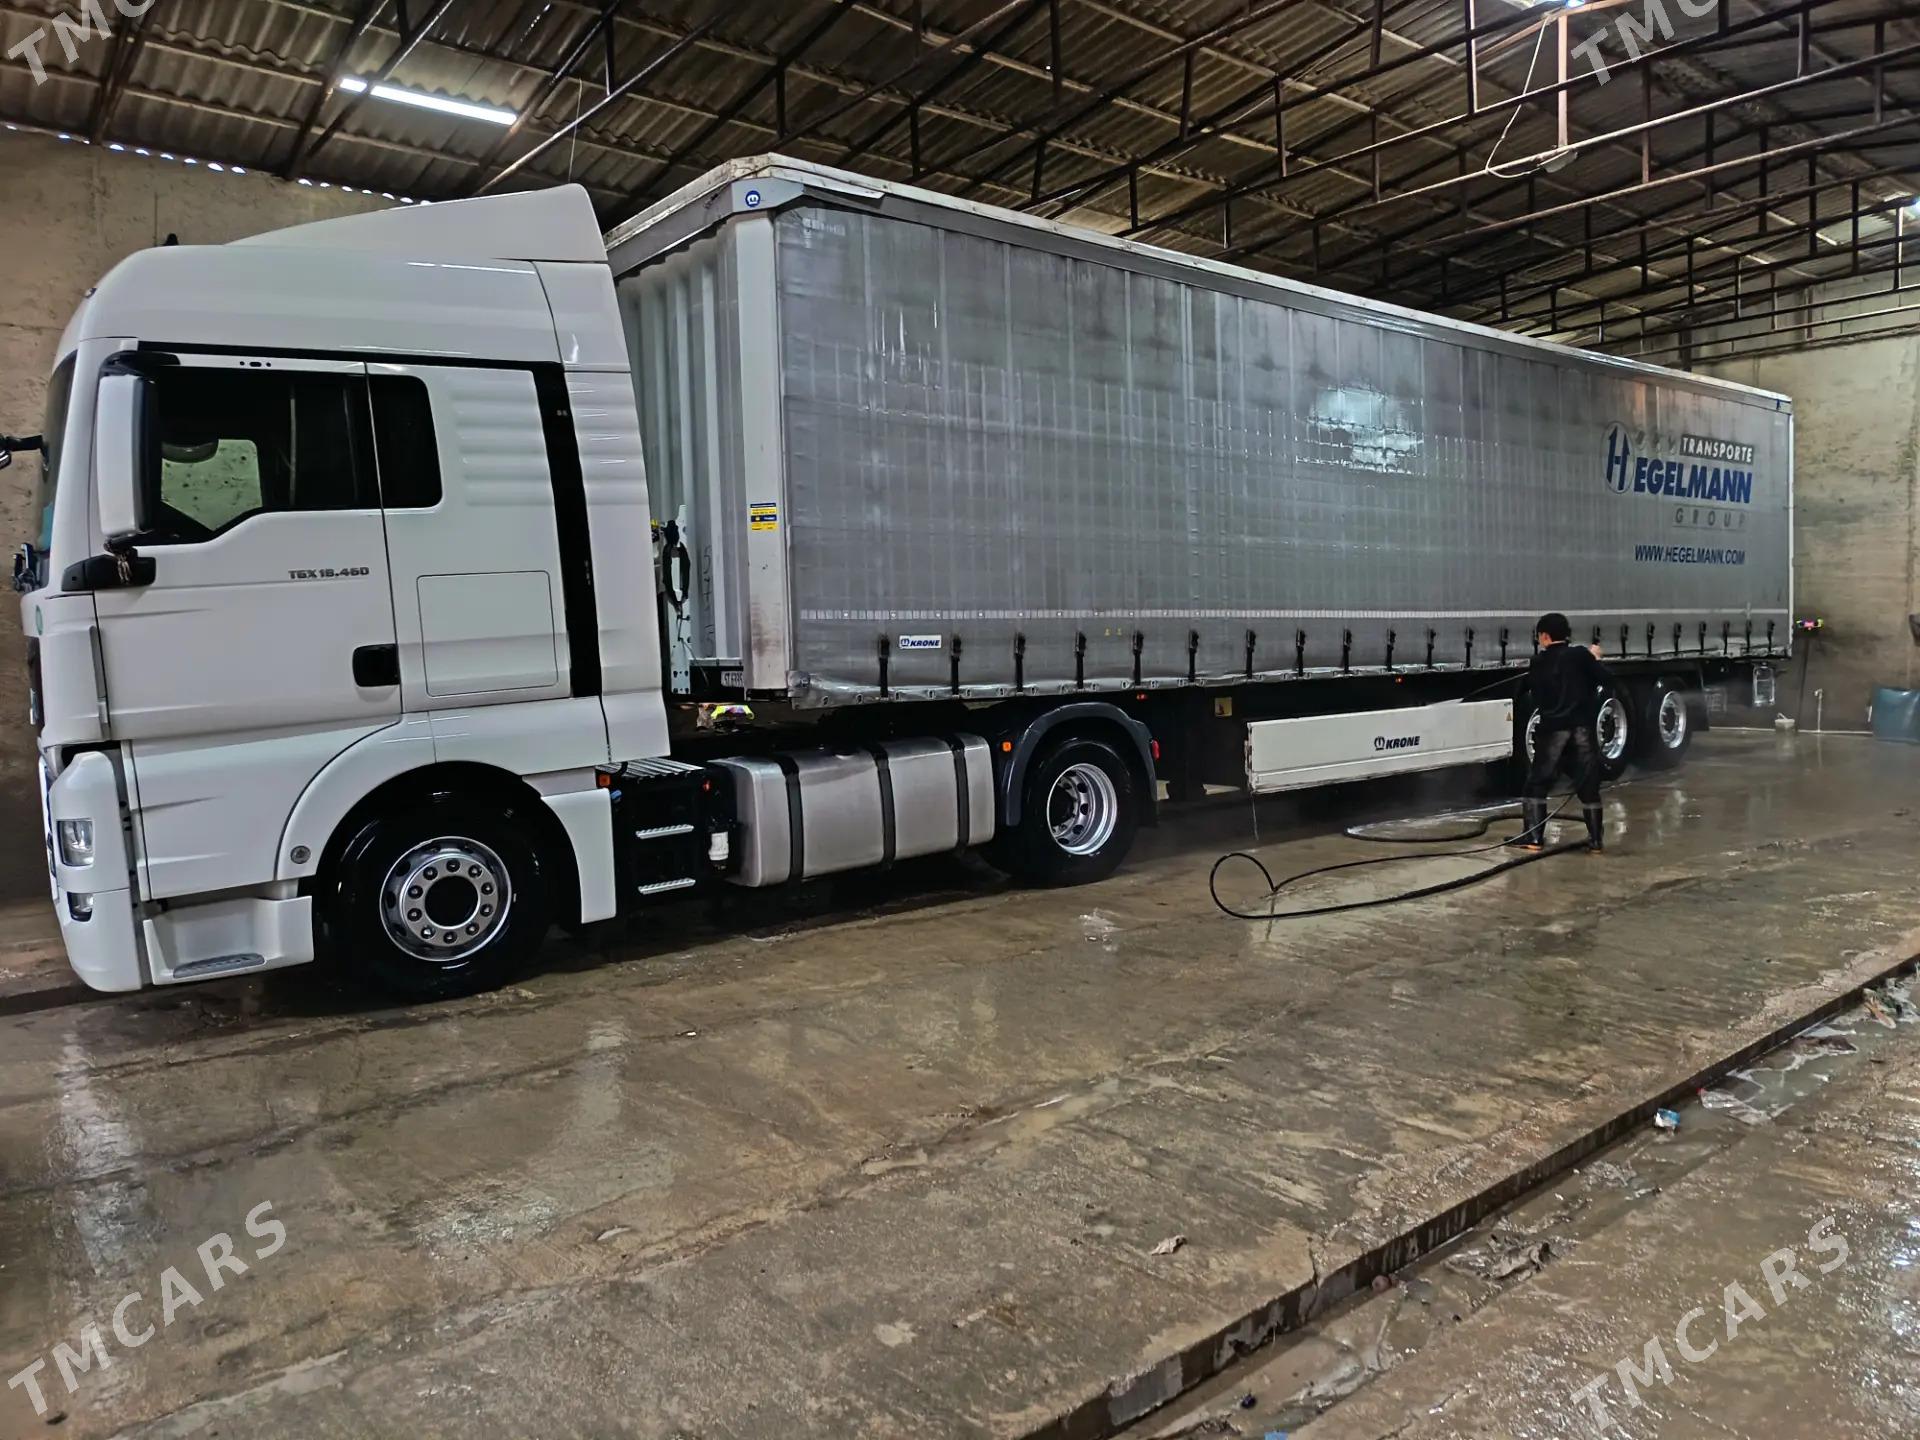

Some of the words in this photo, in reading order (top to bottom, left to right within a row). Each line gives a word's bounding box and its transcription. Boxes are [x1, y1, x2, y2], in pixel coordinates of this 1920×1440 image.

[1683, 437, 1753, 463] TRANSPORTE
[1675, 507, 1746, 527] GROUP
[1634, 545, 1745, 565] WWW.HEGELMANN.COM
[1386, 736, 1420, 749] KRONE
